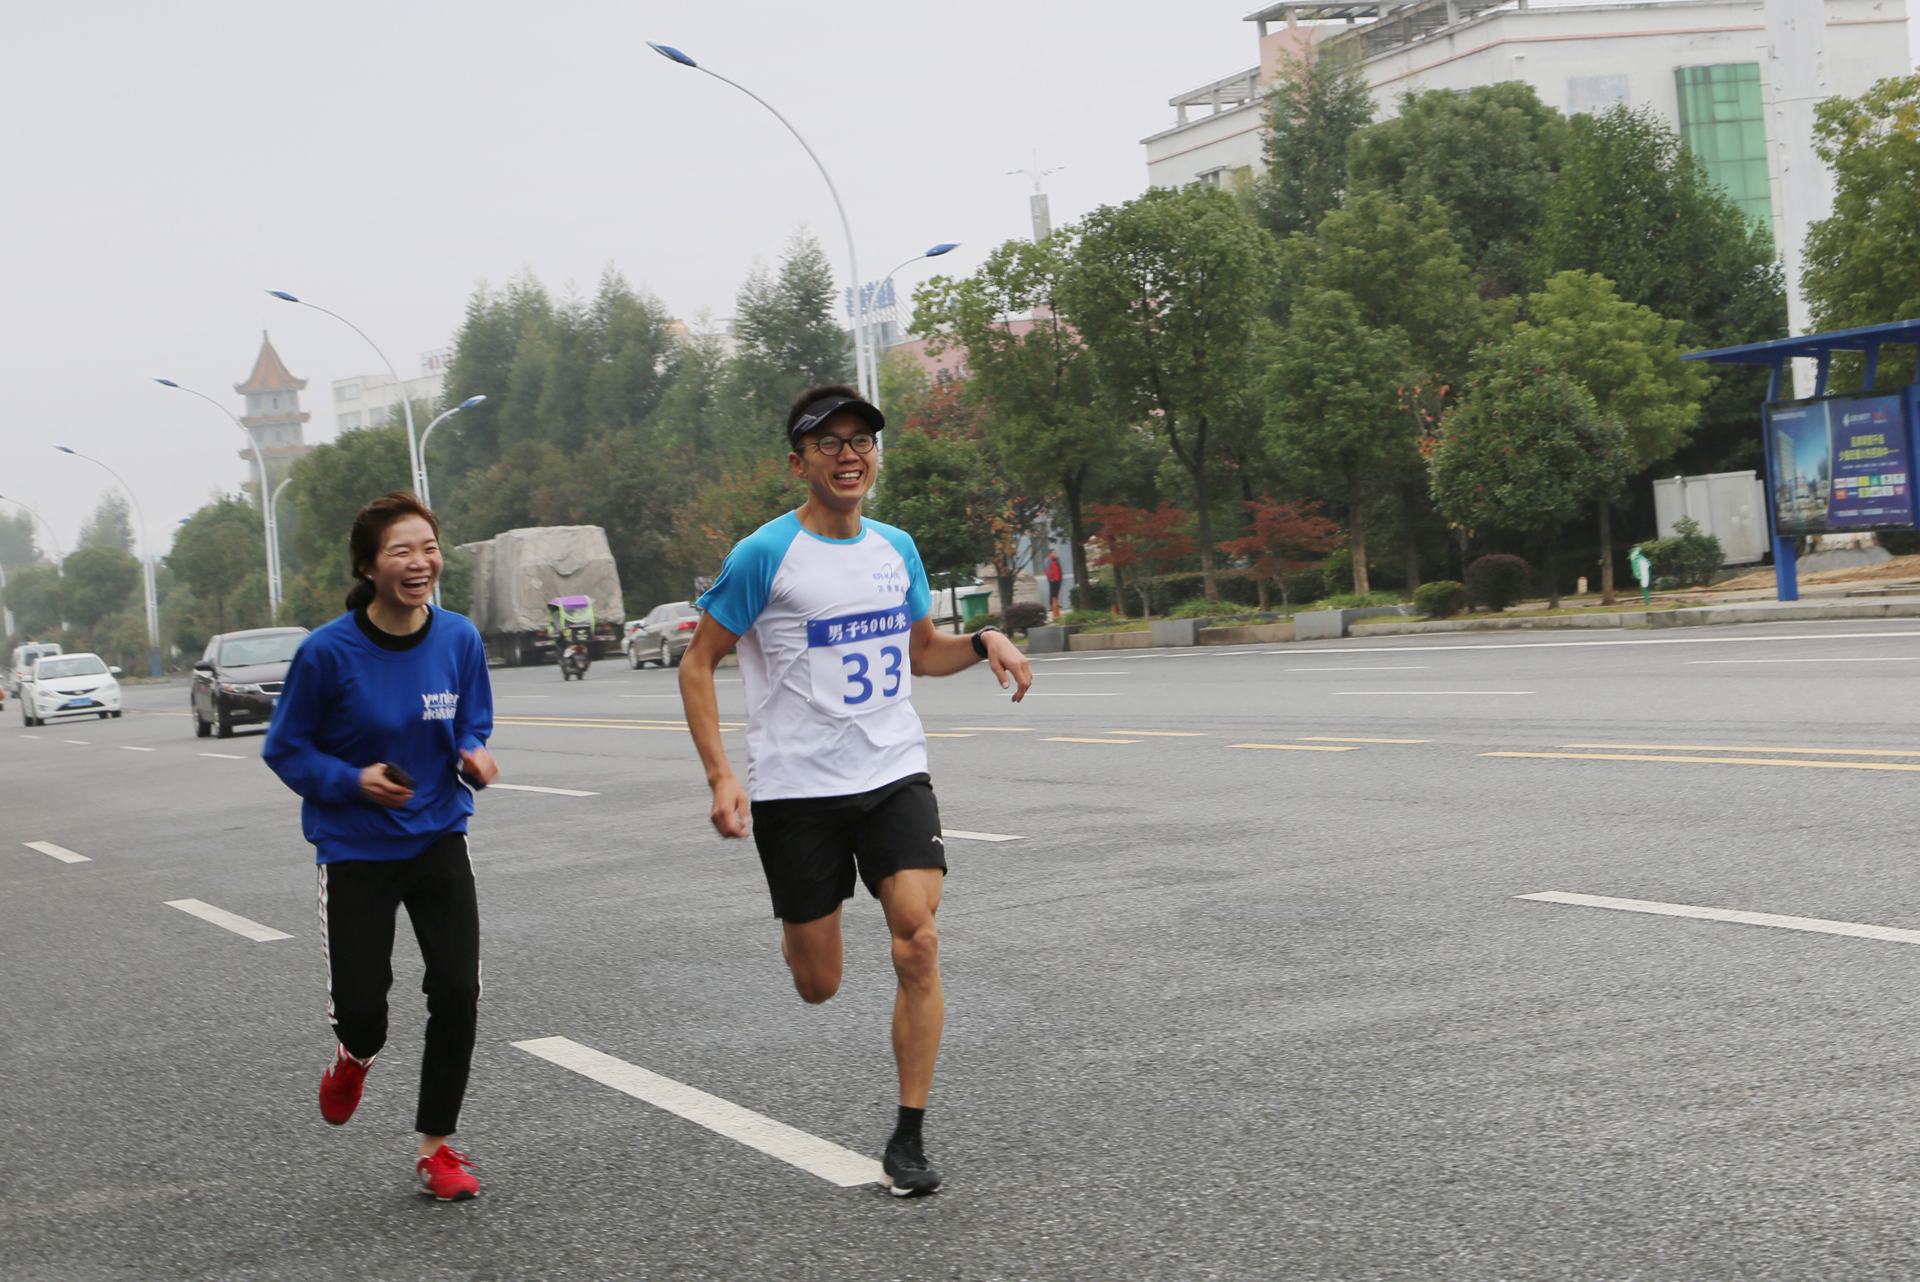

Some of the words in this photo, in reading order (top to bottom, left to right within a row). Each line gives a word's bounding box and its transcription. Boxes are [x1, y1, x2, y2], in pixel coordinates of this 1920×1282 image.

[828, 612, 906, 642] 男子5000米
[842, 645, 902, 704] 33
